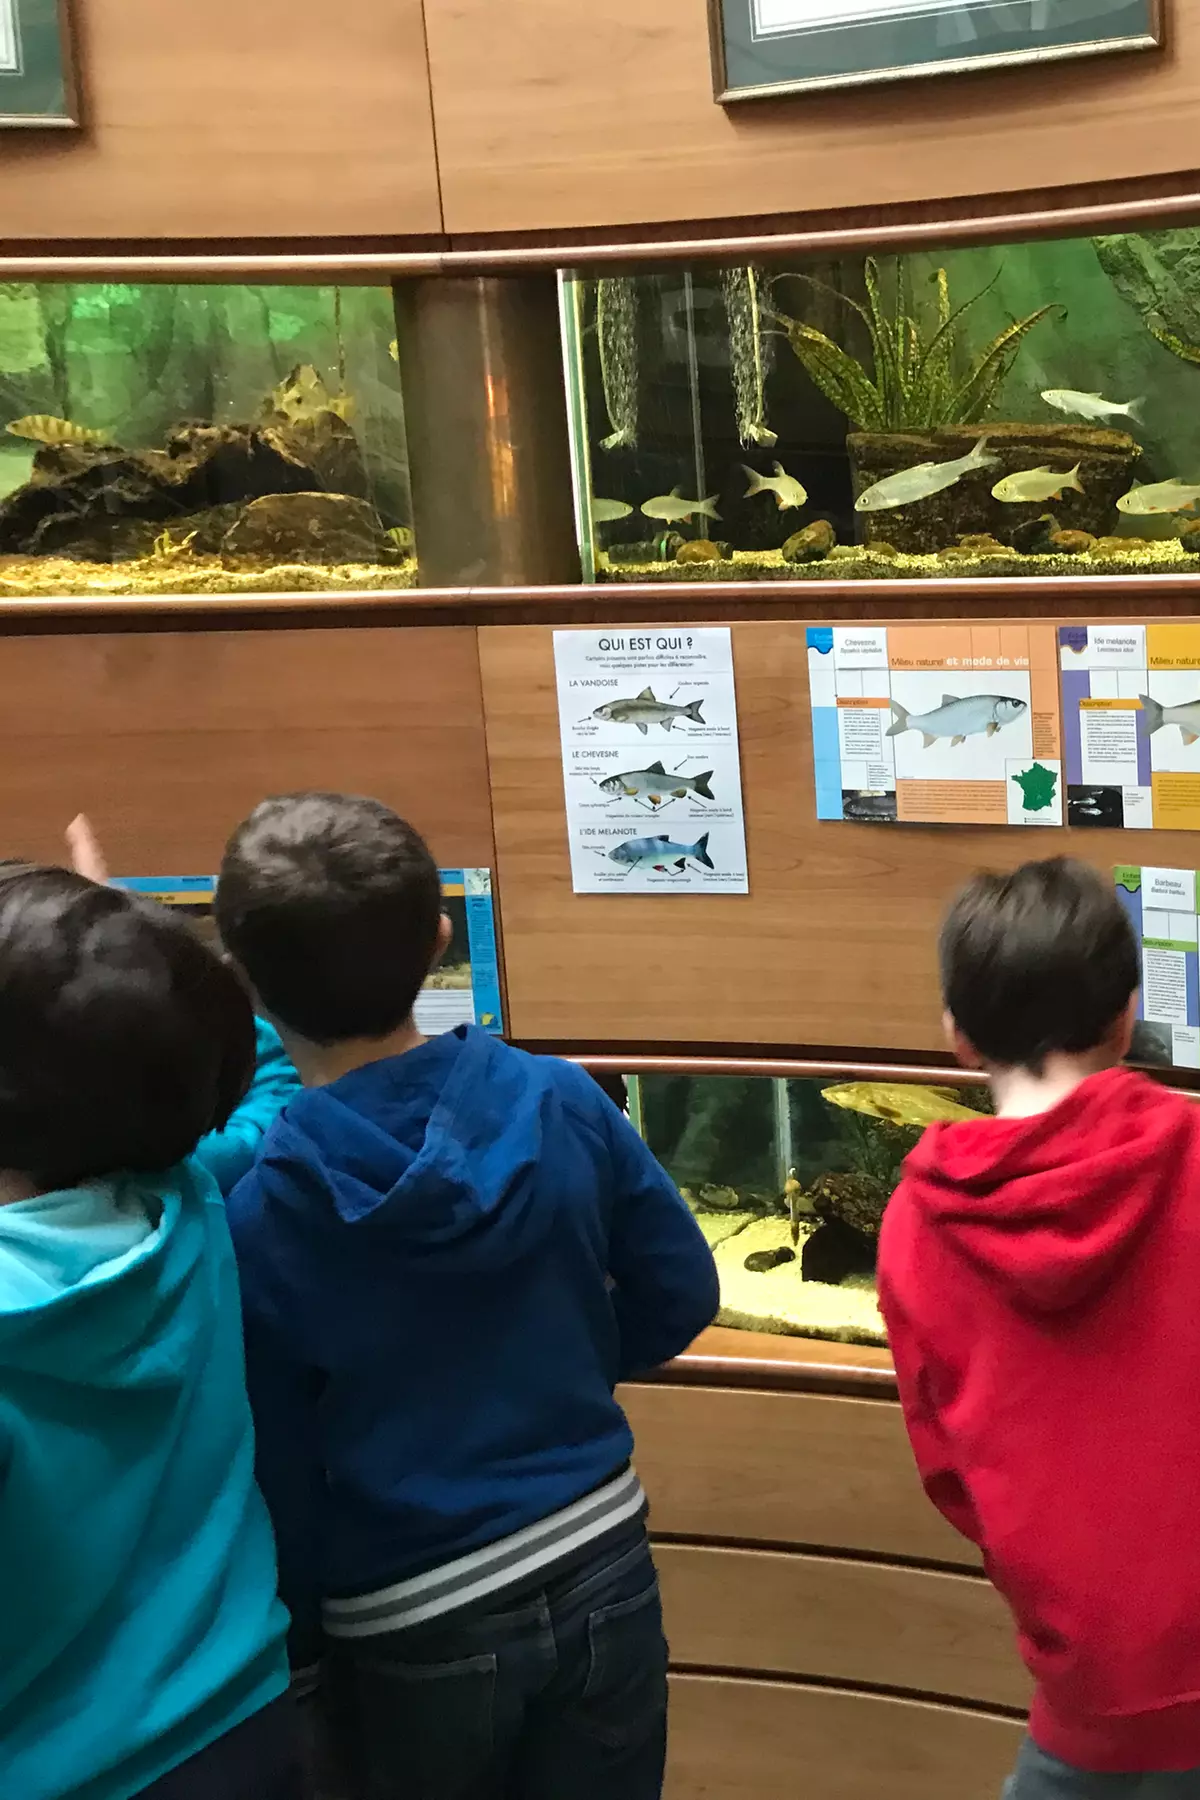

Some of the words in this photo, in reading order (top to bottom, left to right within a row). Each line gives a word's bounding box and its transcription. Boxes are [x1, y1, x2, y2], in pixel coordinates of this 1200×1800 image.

[599, 638, 624, 651] QUI
[629, 637, 651, 650] EST
[656, 637, 682, 650] QUI
[686, 636, 693, 649] ?
[891, 657, 914, 666] Milieu
[916, 657, 944, 666] naturel
[946, 656, 958, 666] et
[962, 656, 992, 666] mode
[996, 656, 1010, 666] de
[1013, 656, 1030, 666] vie
[1150, 657, 1173, 666] Milieu
[580, 679, 618, 687] VANDOISE
[579, 828, 596, 836] L'IDE
